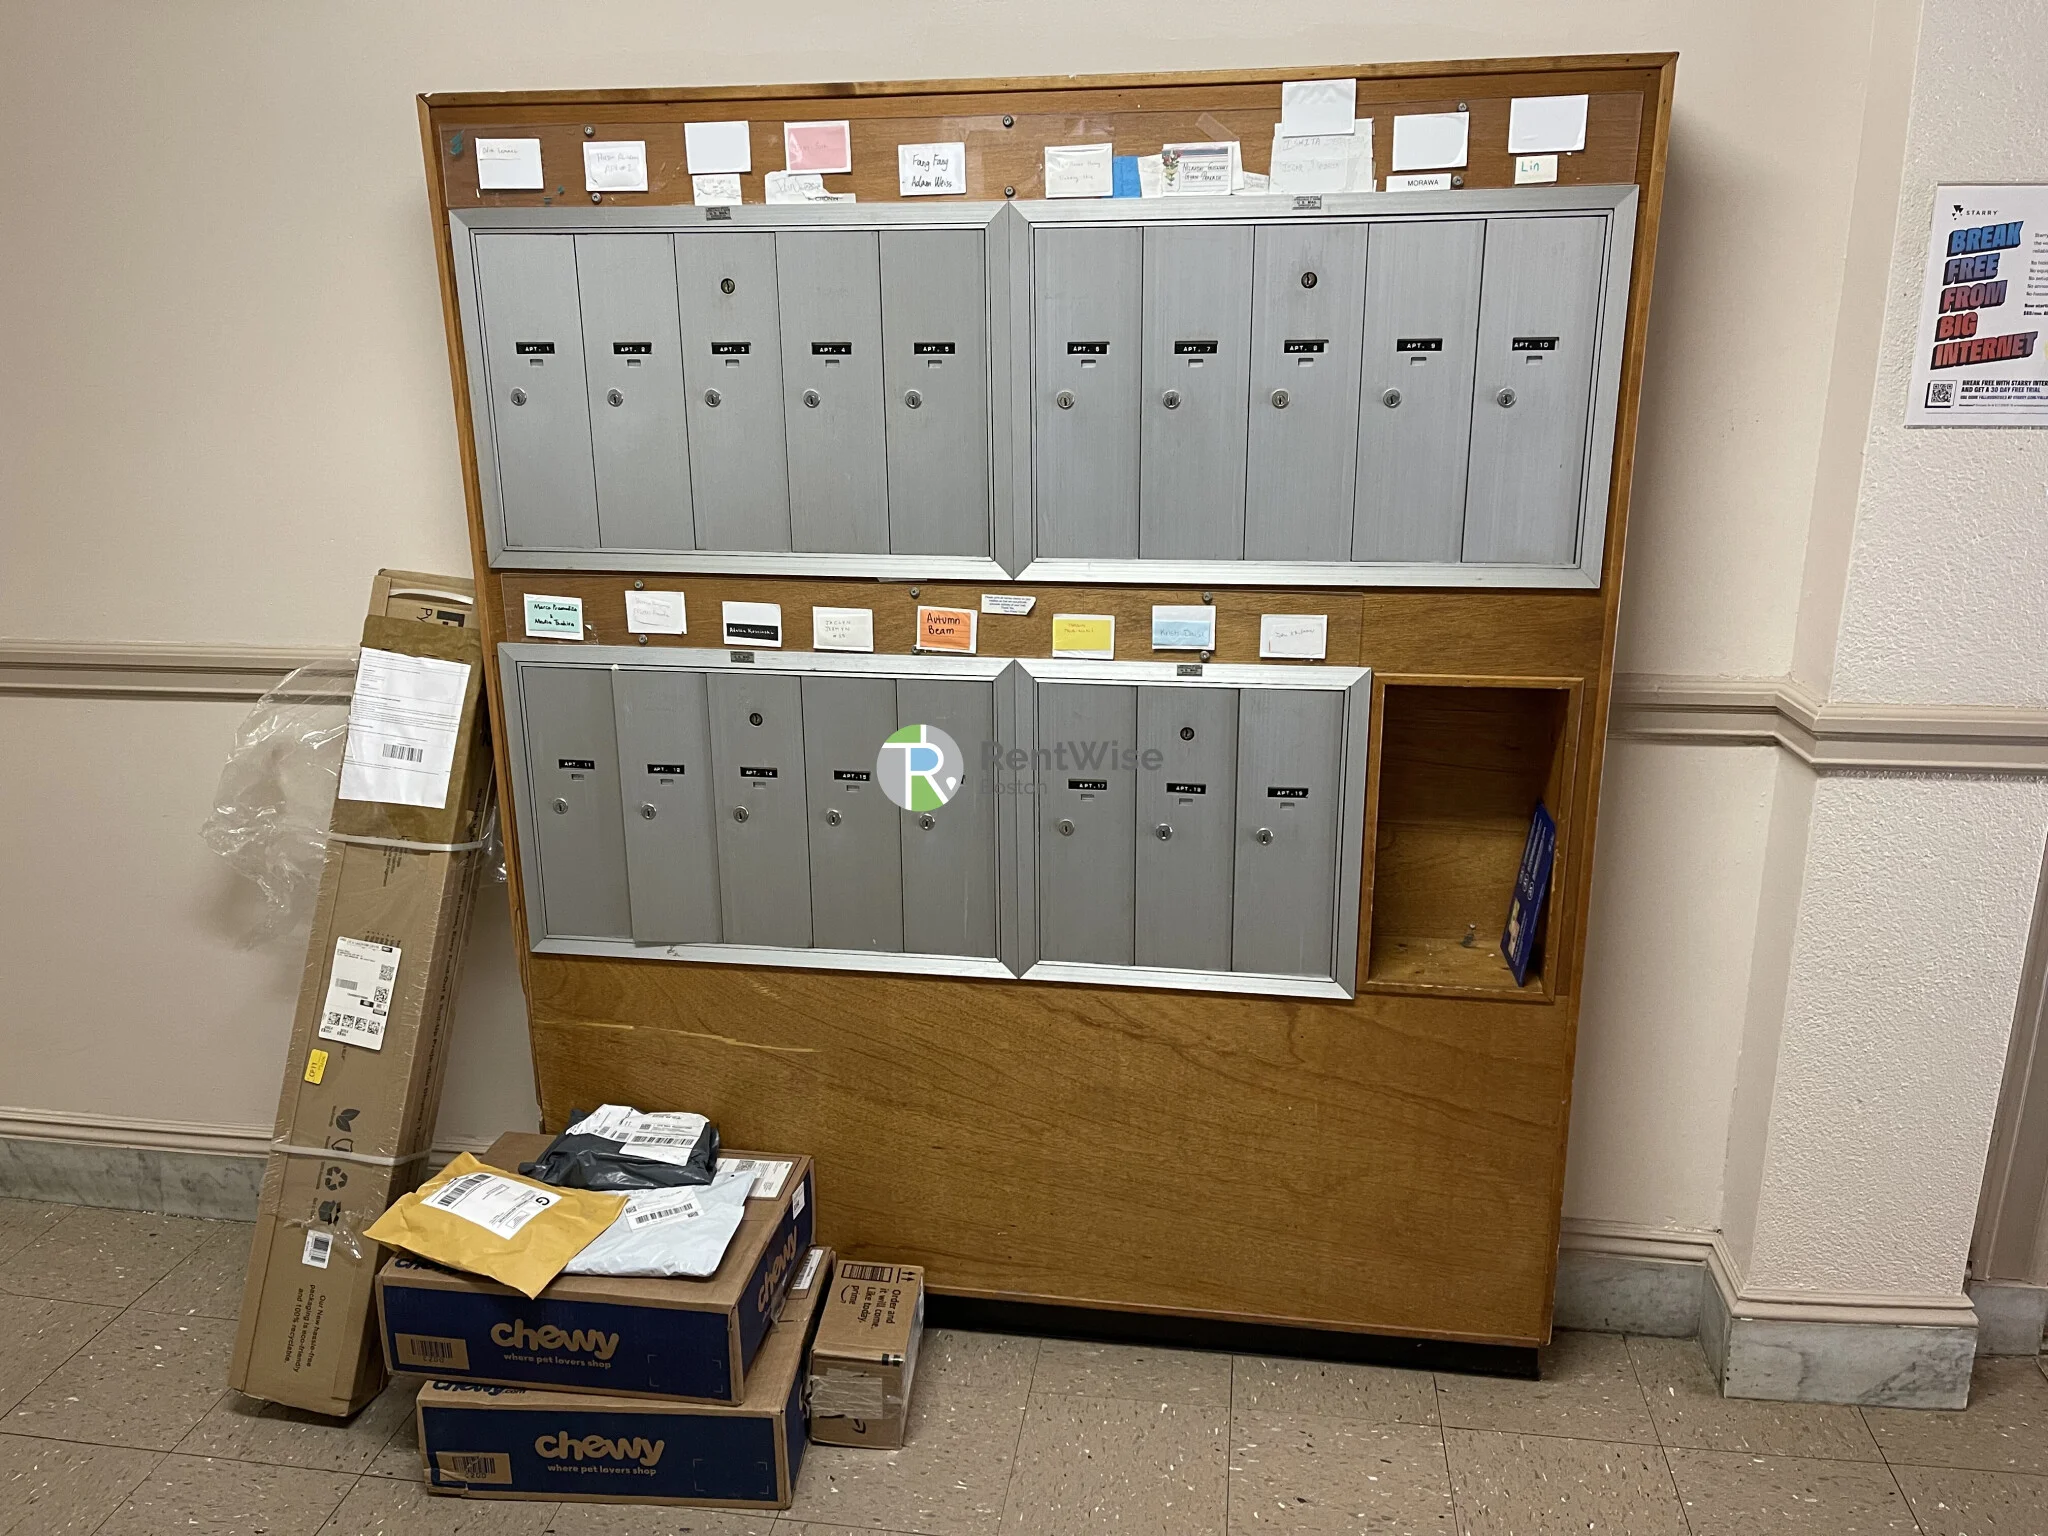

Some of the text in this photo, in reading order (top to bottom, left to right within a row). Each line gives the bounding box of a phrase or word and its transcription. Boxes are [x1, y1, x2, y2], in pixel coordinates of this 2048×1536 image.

[912, 153, 950, 172] Fang Fang
[1521, 161, 1540, 172] Lin
[911, 176, 953, 188] Adam Weiss
[1407, 178, 1439, 187] MORAWA
[1946, 221, 2024, 257] BREAK
[1943, 253, 2001, 286] FREE
[1938, 280, 2008, 314] FROM
[1934, 312, 1979, 342] BIG
[1930, 331, 2038, 370] INTERNET
[926, 612, 961, 625] Autumn
[928, 625, 955, 635] Beam
[303, 1284, 316, 1321] packaging
[849, 1285, 860, 1305] prime
[864, 1287, 876, 1301] Like
[876, 1295, 887, 1307] will
[292, 1304, 302, 1323] 100%
[886, 1289, 901, 1324] Order and
[315, 1309, 324, 1325] New
[870, 1309, 882, 1329] come.
[490, 1318, 619, 1360] chewy
[503, 1353, 612, 1370] where pet lovers shop
[534, 1430, 665, 1467] chewy
[547, 1464, 657, 1477] where pet lovers shop
